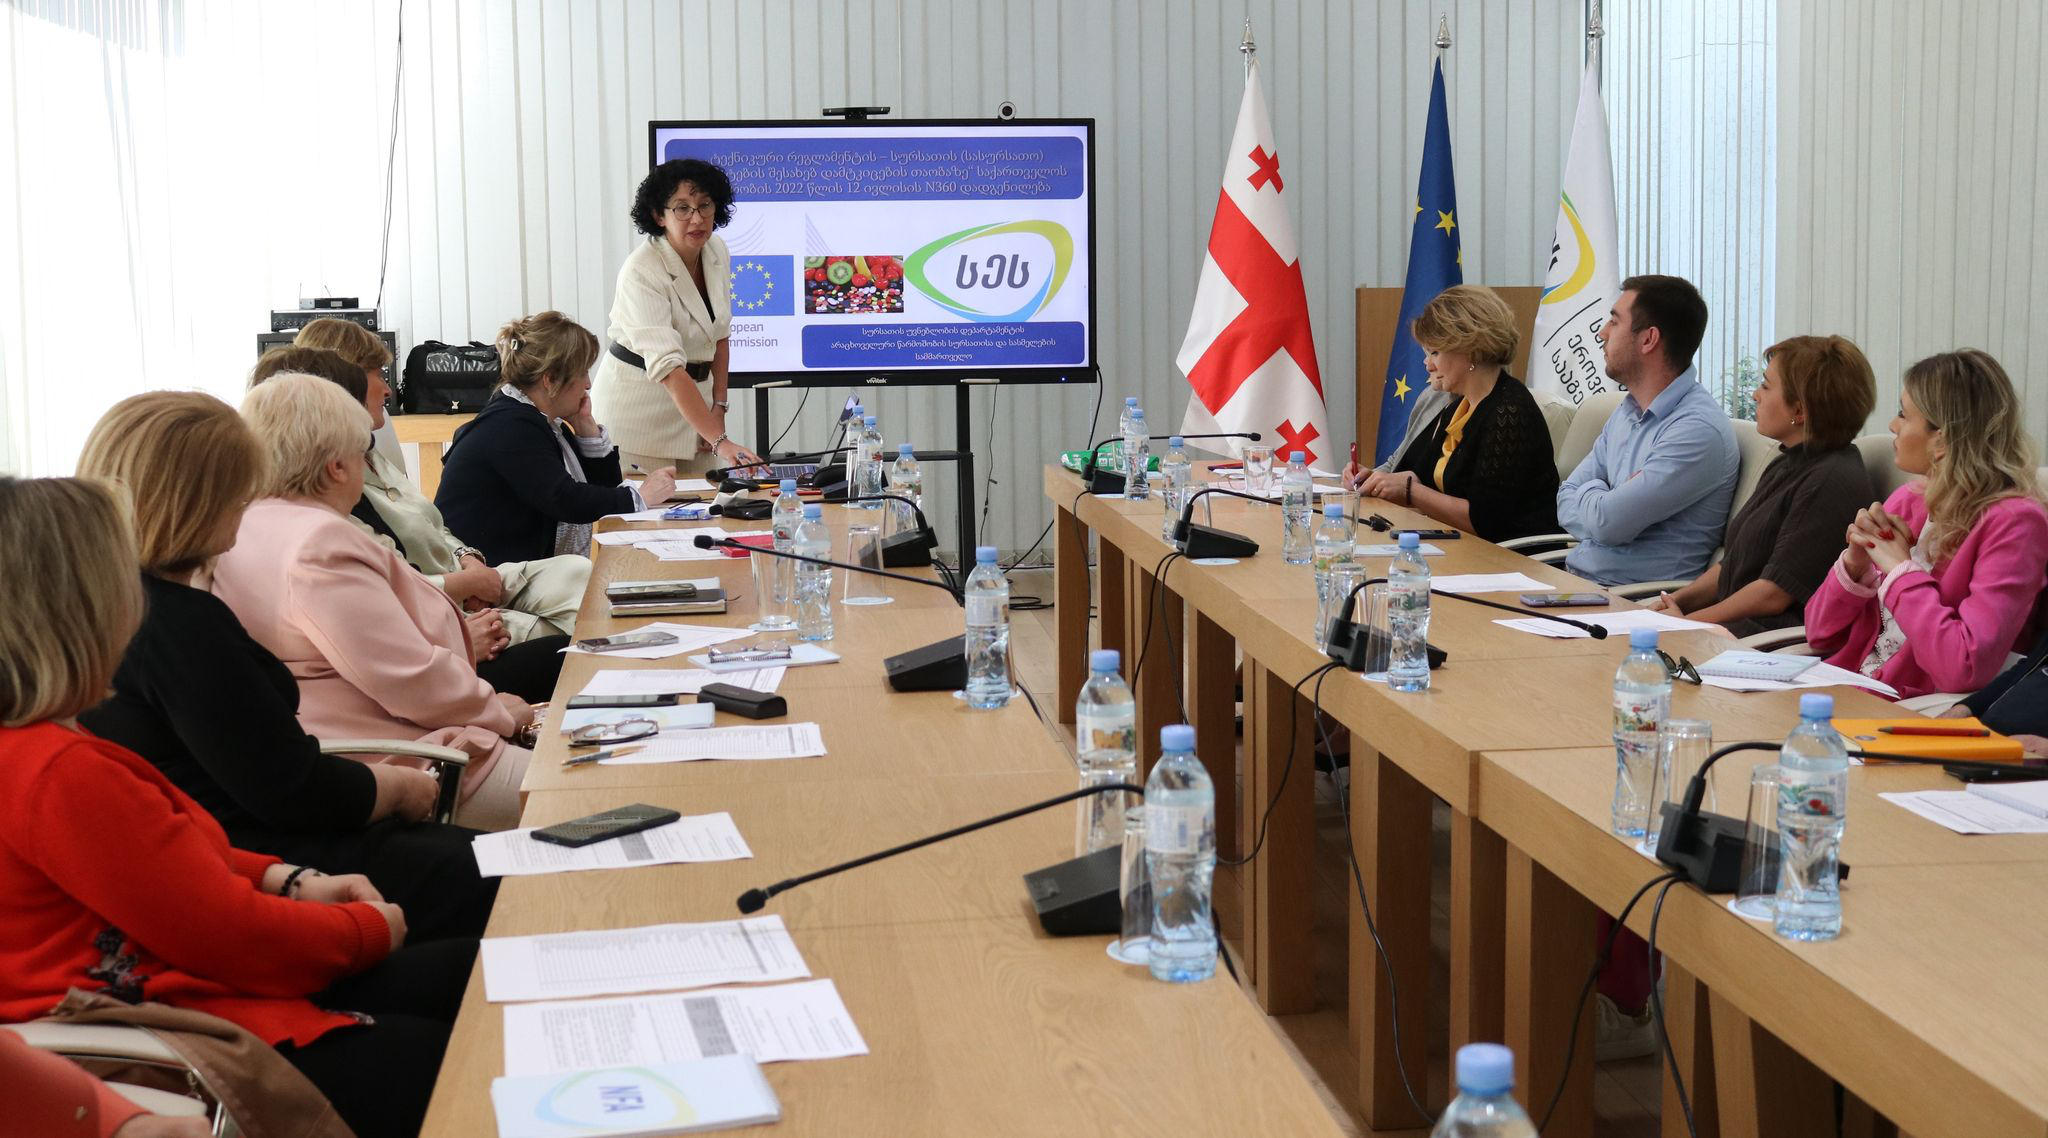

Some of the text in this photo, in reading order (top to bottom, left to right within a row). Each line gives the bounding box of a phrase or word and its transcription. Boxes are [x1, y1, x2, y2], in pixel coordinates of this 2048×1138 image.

[890, 149, 958, 164] სურსათის
[775, 181, 804, 194] 2022
[806, 181, 843, 198] წლის
[847, 181, 861, 194] 12
[956, 253, 1030, 290] სეს
[730, 323, 764, 335] opean
[729, 336, 778, 347] mmission
